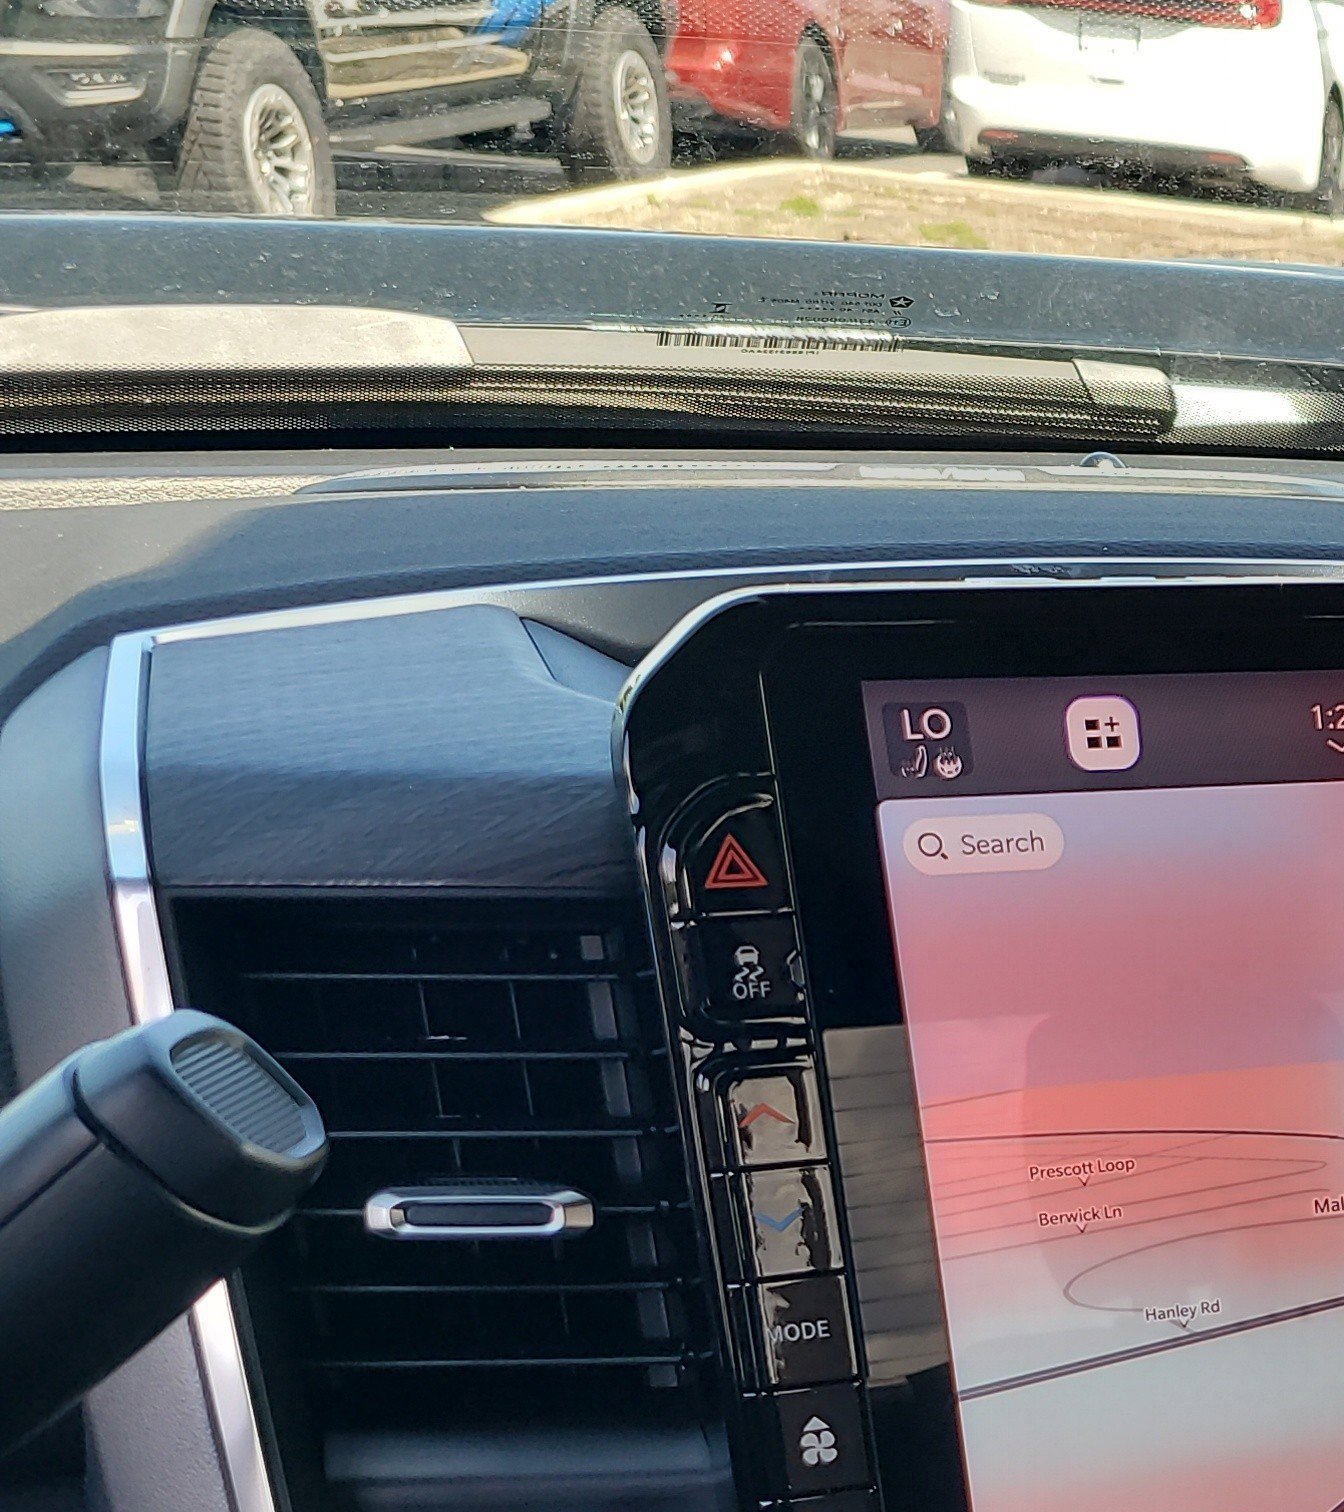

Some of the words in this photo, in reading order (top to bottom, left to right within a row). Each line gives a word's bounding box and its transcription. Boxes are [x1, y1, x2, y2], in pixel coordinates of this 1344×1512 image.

[901, 707, 953, 742] LO
[960, 828, 1045, 858] Search
[732, 980, 772, 1000] OFF
[1029, 1161, 1093, 1180] Prescott
[1097, 1157, 1136, 1175] Loop
[1038, 1208, 1100, 1227] Berwick
[1104, 1206, 1122, 1220] Ln
[1145, 1303, 1197, 1322] Hanley
[1201, 1299, 1220, 1315] Rd
[766, 1319, 831, 1343] MODE
